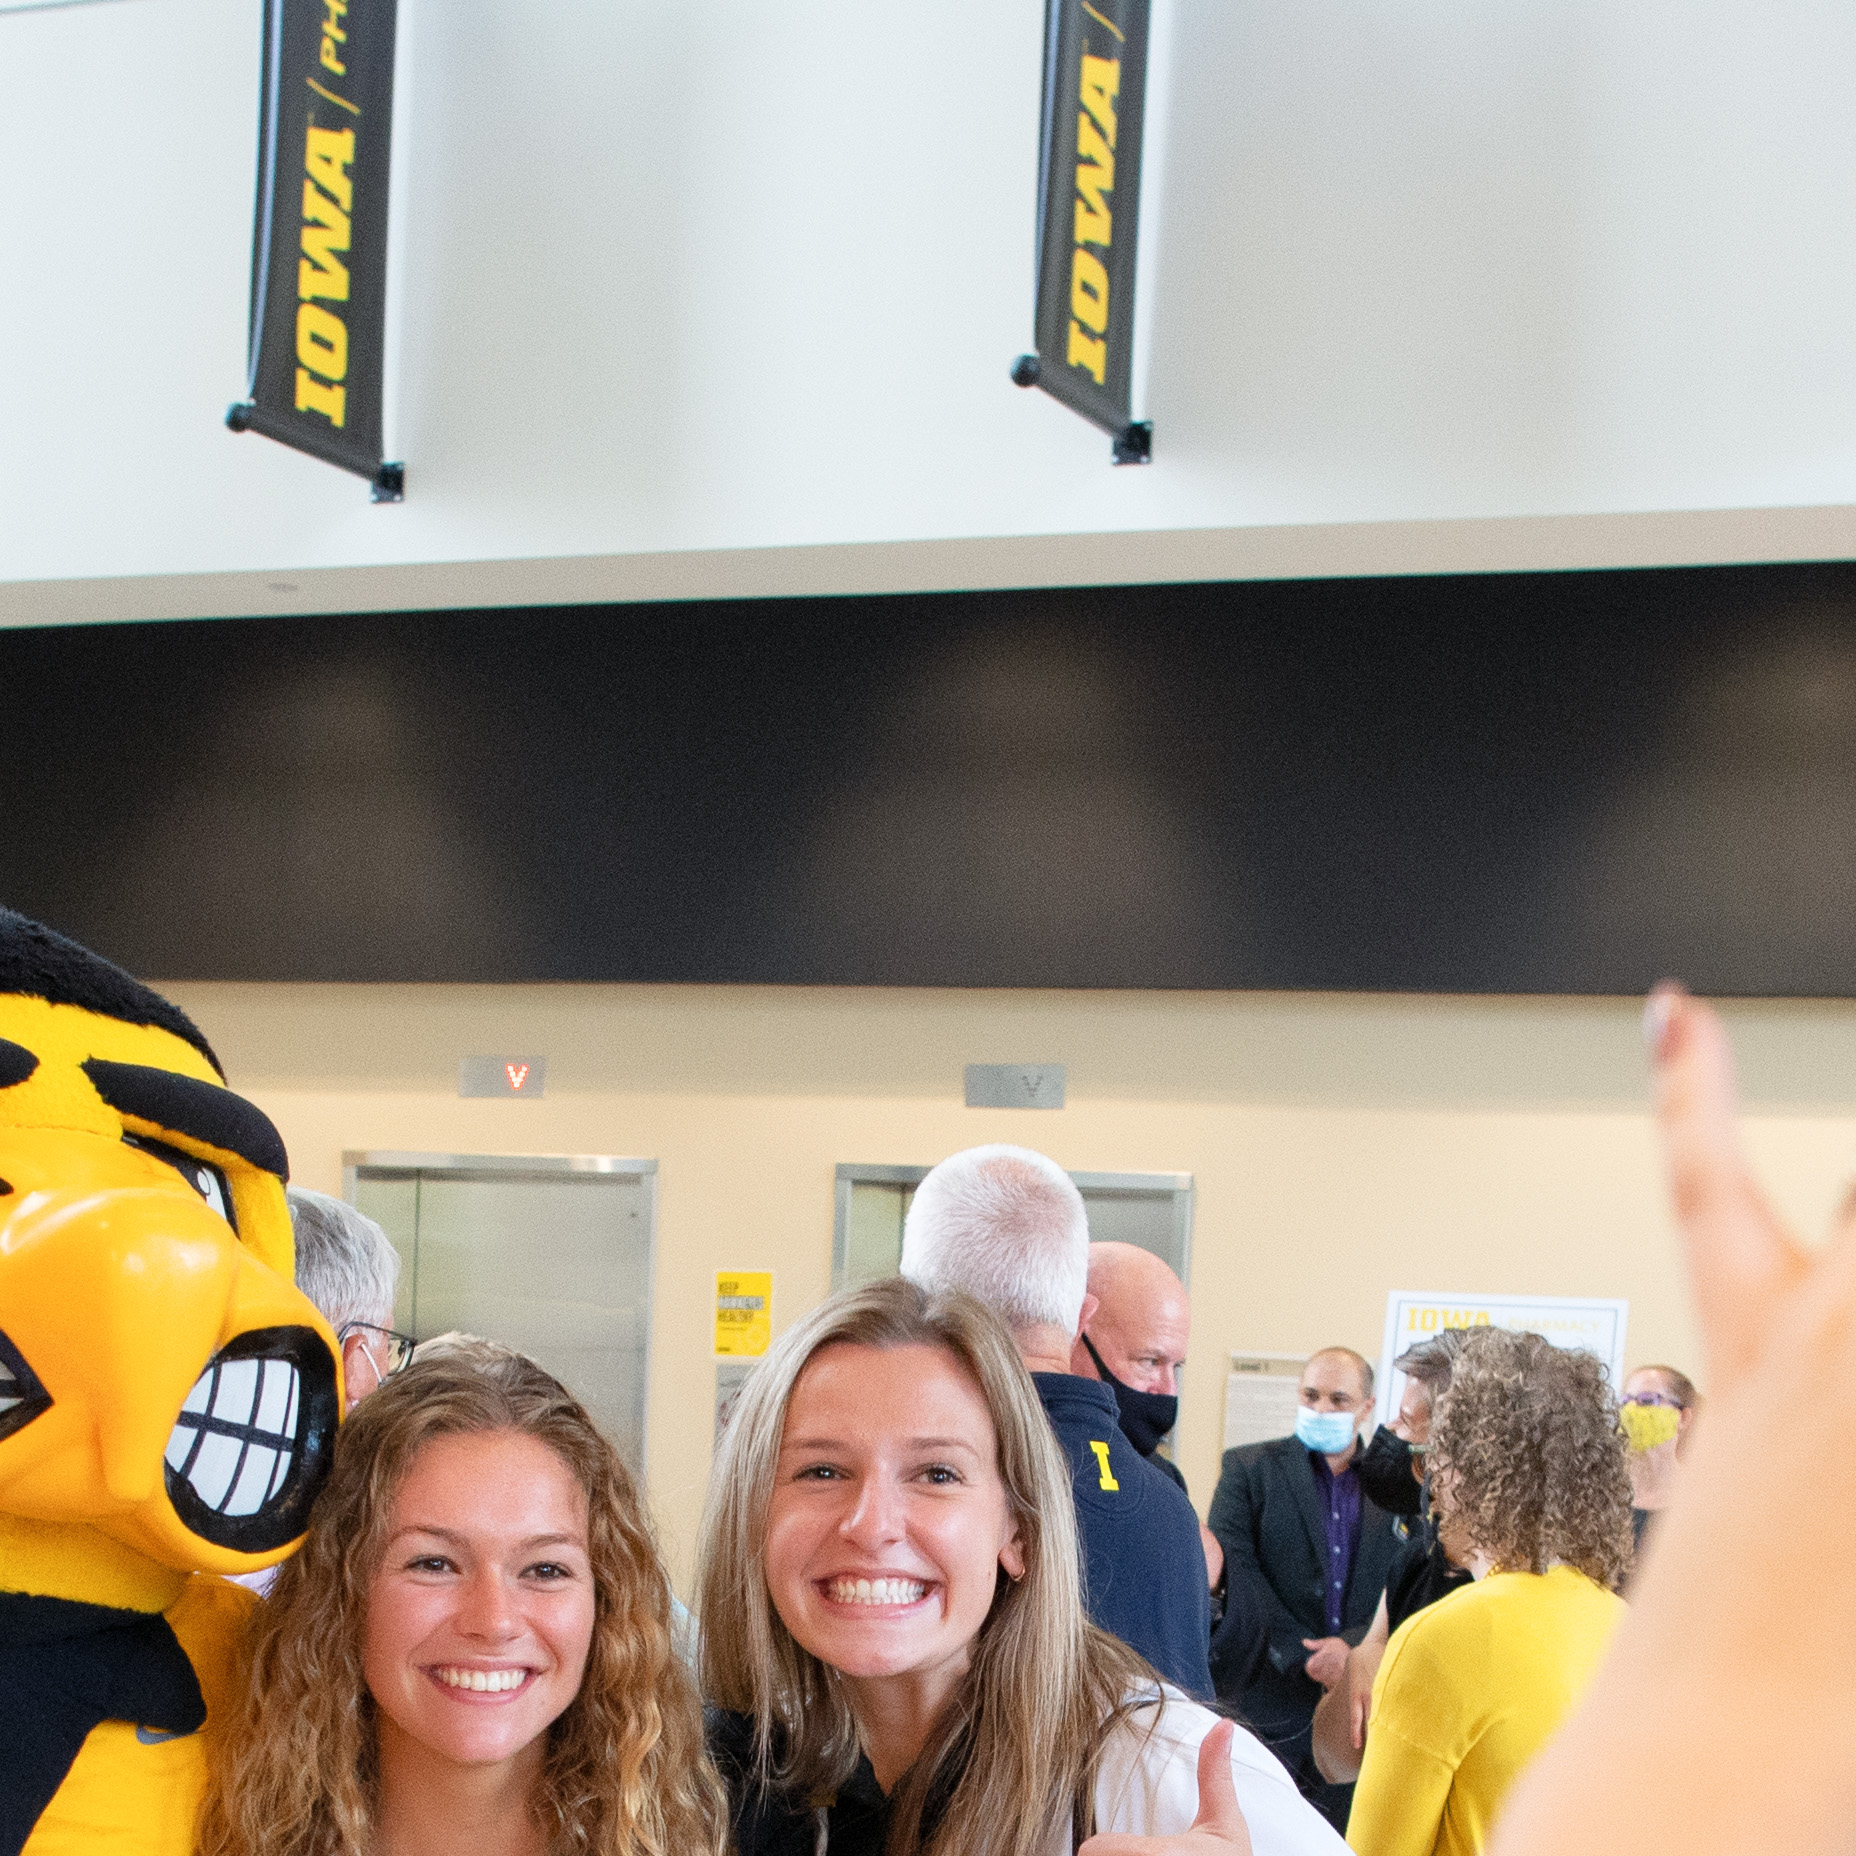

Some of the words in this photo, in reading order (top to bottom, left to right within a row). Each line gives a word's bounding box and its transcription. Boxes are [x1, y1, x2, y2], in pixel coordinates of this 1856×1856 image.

[294, 127, 356, 429] IOWA
[1067, 54, 1121, 385] IOWA
[1408, 1307, 1491, 1332] IOWA
[1089, 1439, 1120, 1492] I
